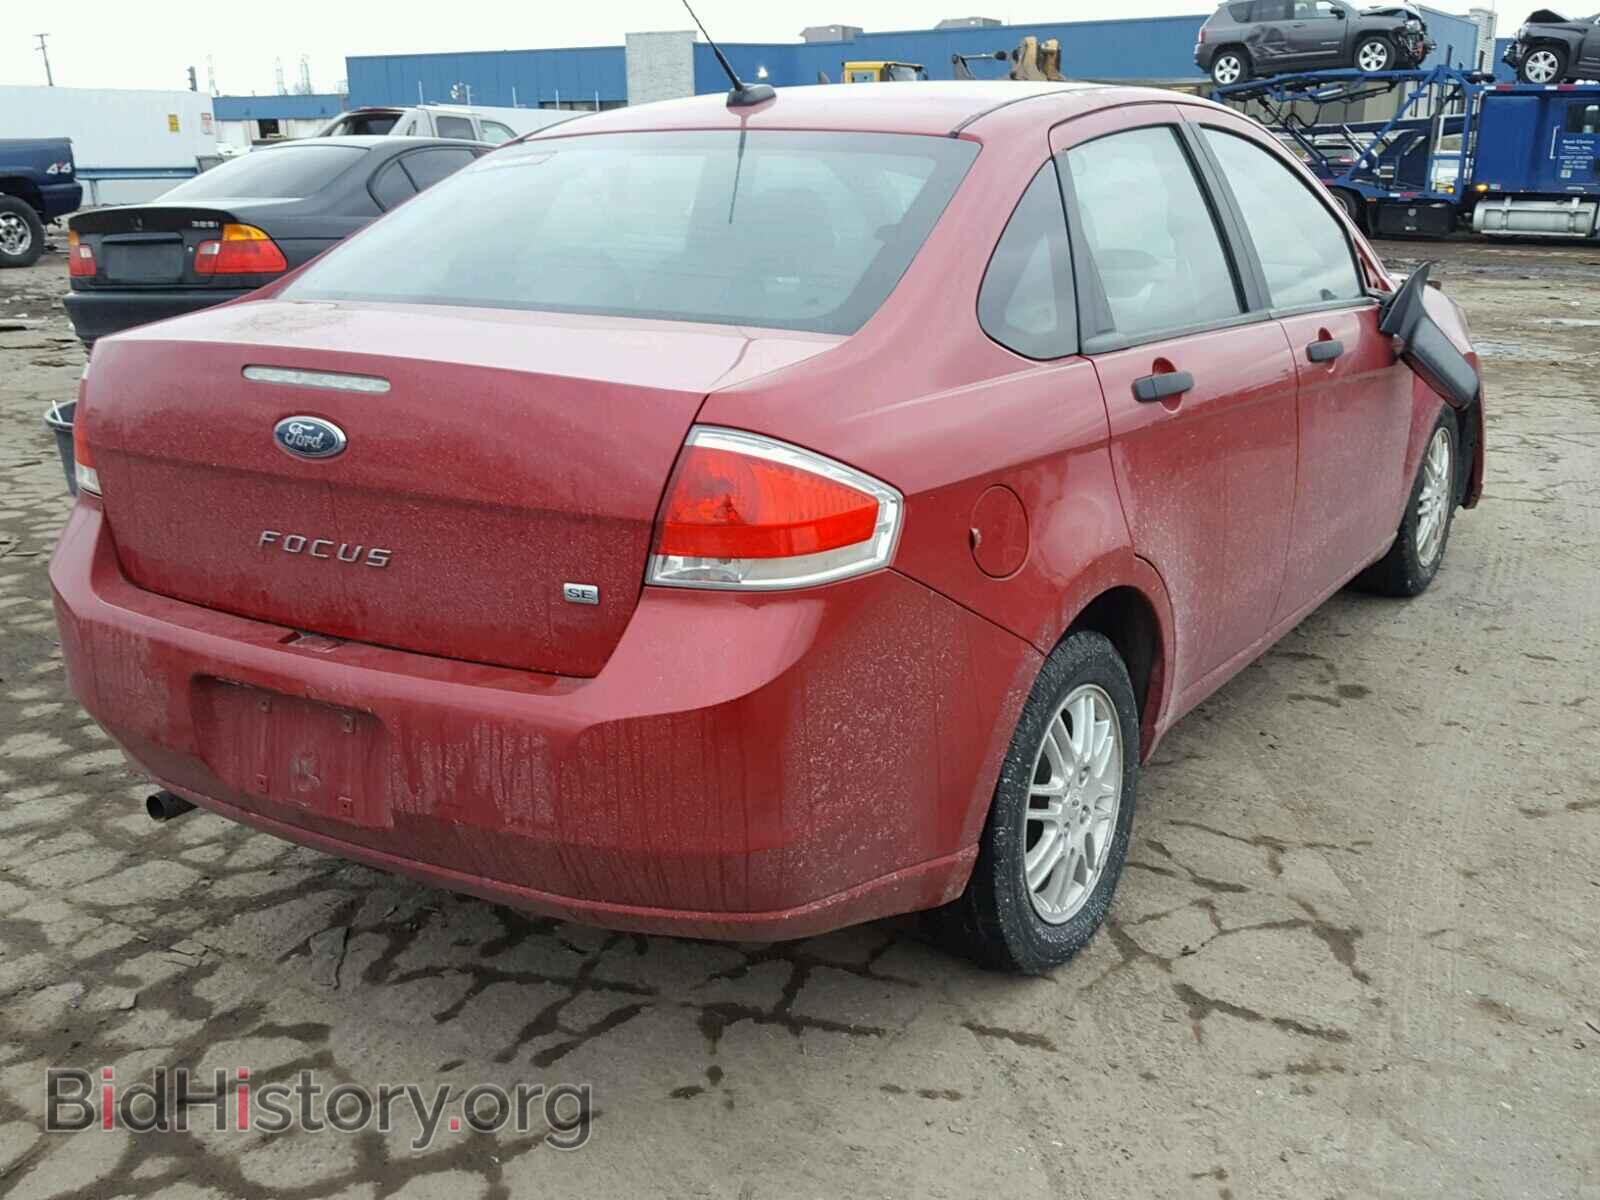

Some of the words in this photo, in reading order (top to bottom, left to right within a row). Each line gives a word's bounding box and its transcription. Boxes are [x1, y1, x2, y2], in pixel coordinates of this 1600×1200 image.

[284, 422, 326, 449] Ford
[258, 529, 393, 568] FOCUS
[566, 587, 595, 600] SE
